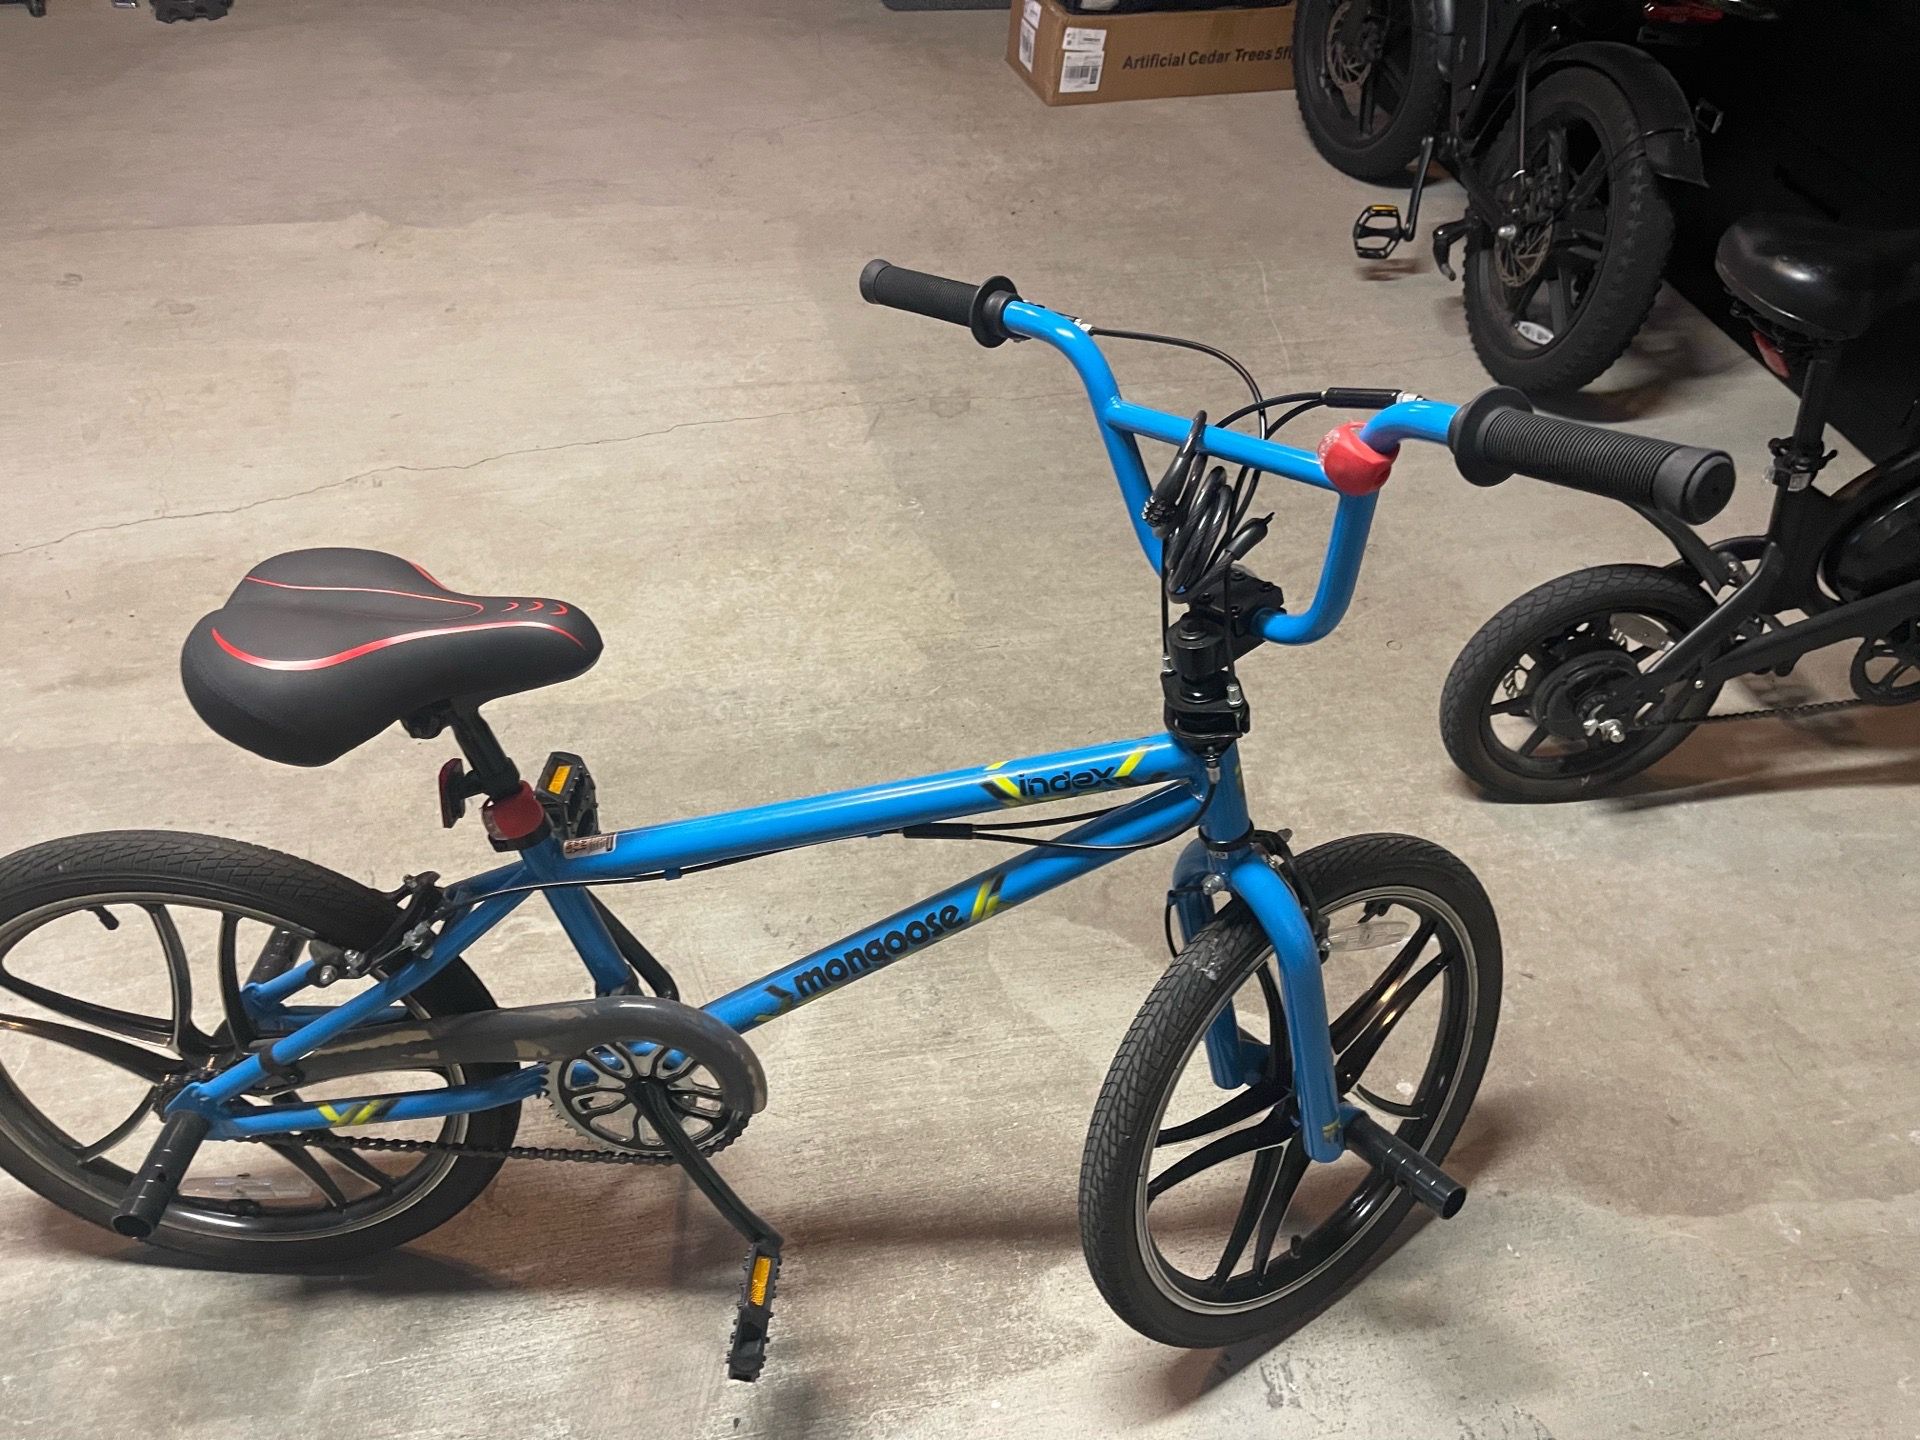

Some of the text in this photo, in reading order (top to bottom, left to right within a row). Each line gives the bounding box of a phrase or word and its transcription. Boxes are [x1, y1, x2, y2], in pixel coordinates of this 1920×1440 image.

[1122, 52, 1186, 70] Artificial
[1188, 50, 1231, 66] Cedar
[1235, 48, 1274, 63] Trees
[1018, 766, 1115, 797] index
[793, 904, 965, 997] mongoose
